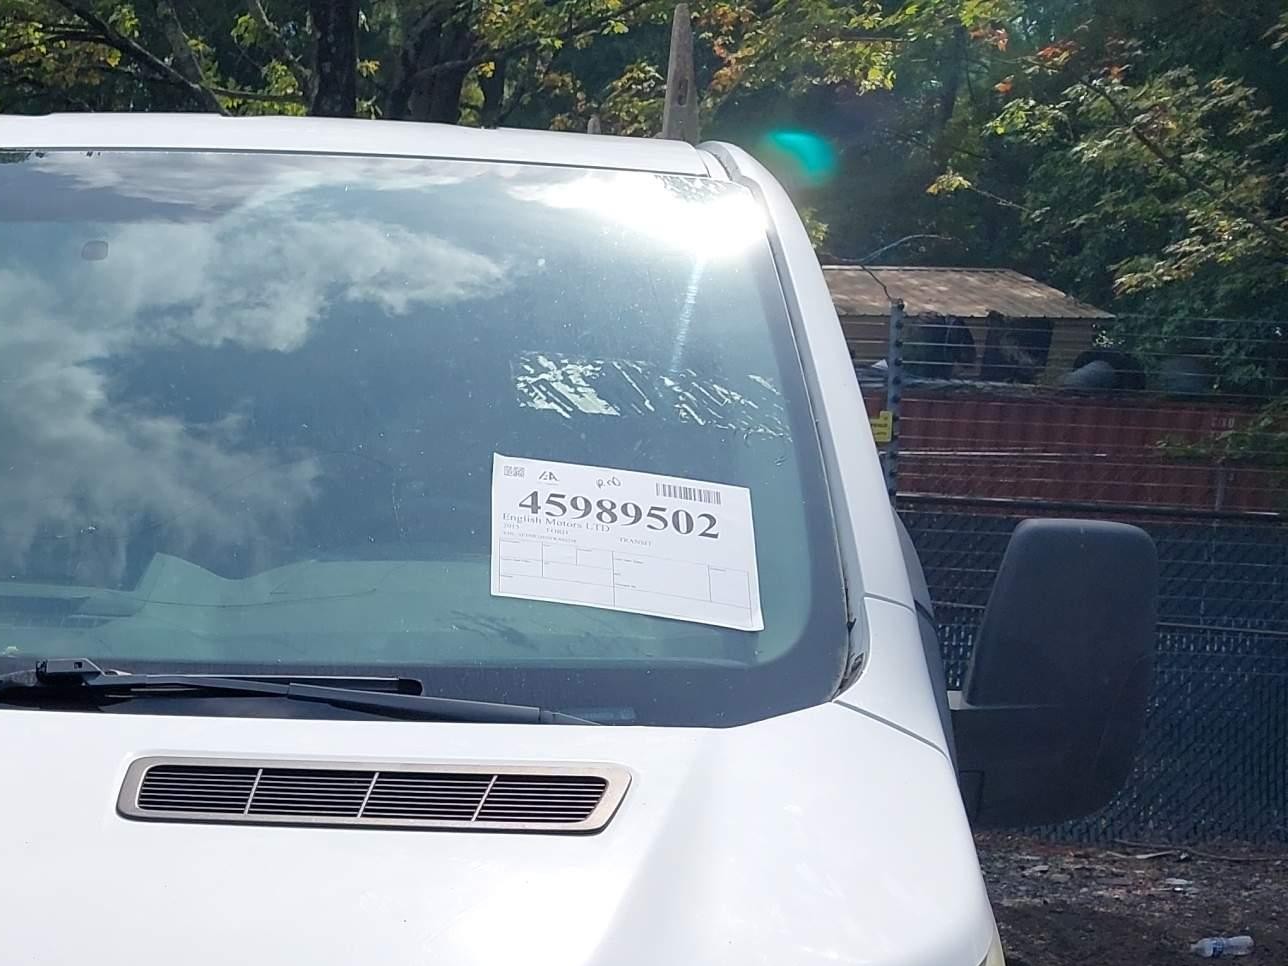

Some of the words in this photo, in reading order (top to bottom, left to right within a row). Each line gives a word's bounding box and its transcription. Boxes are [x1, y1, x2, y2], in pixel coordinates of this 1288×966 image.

[502, 513, 542, 524] English
[545, 518, 583, 529] Motors
[585, 522, 611, 532] LTD
[518, 490, 720, 540] 45989502
